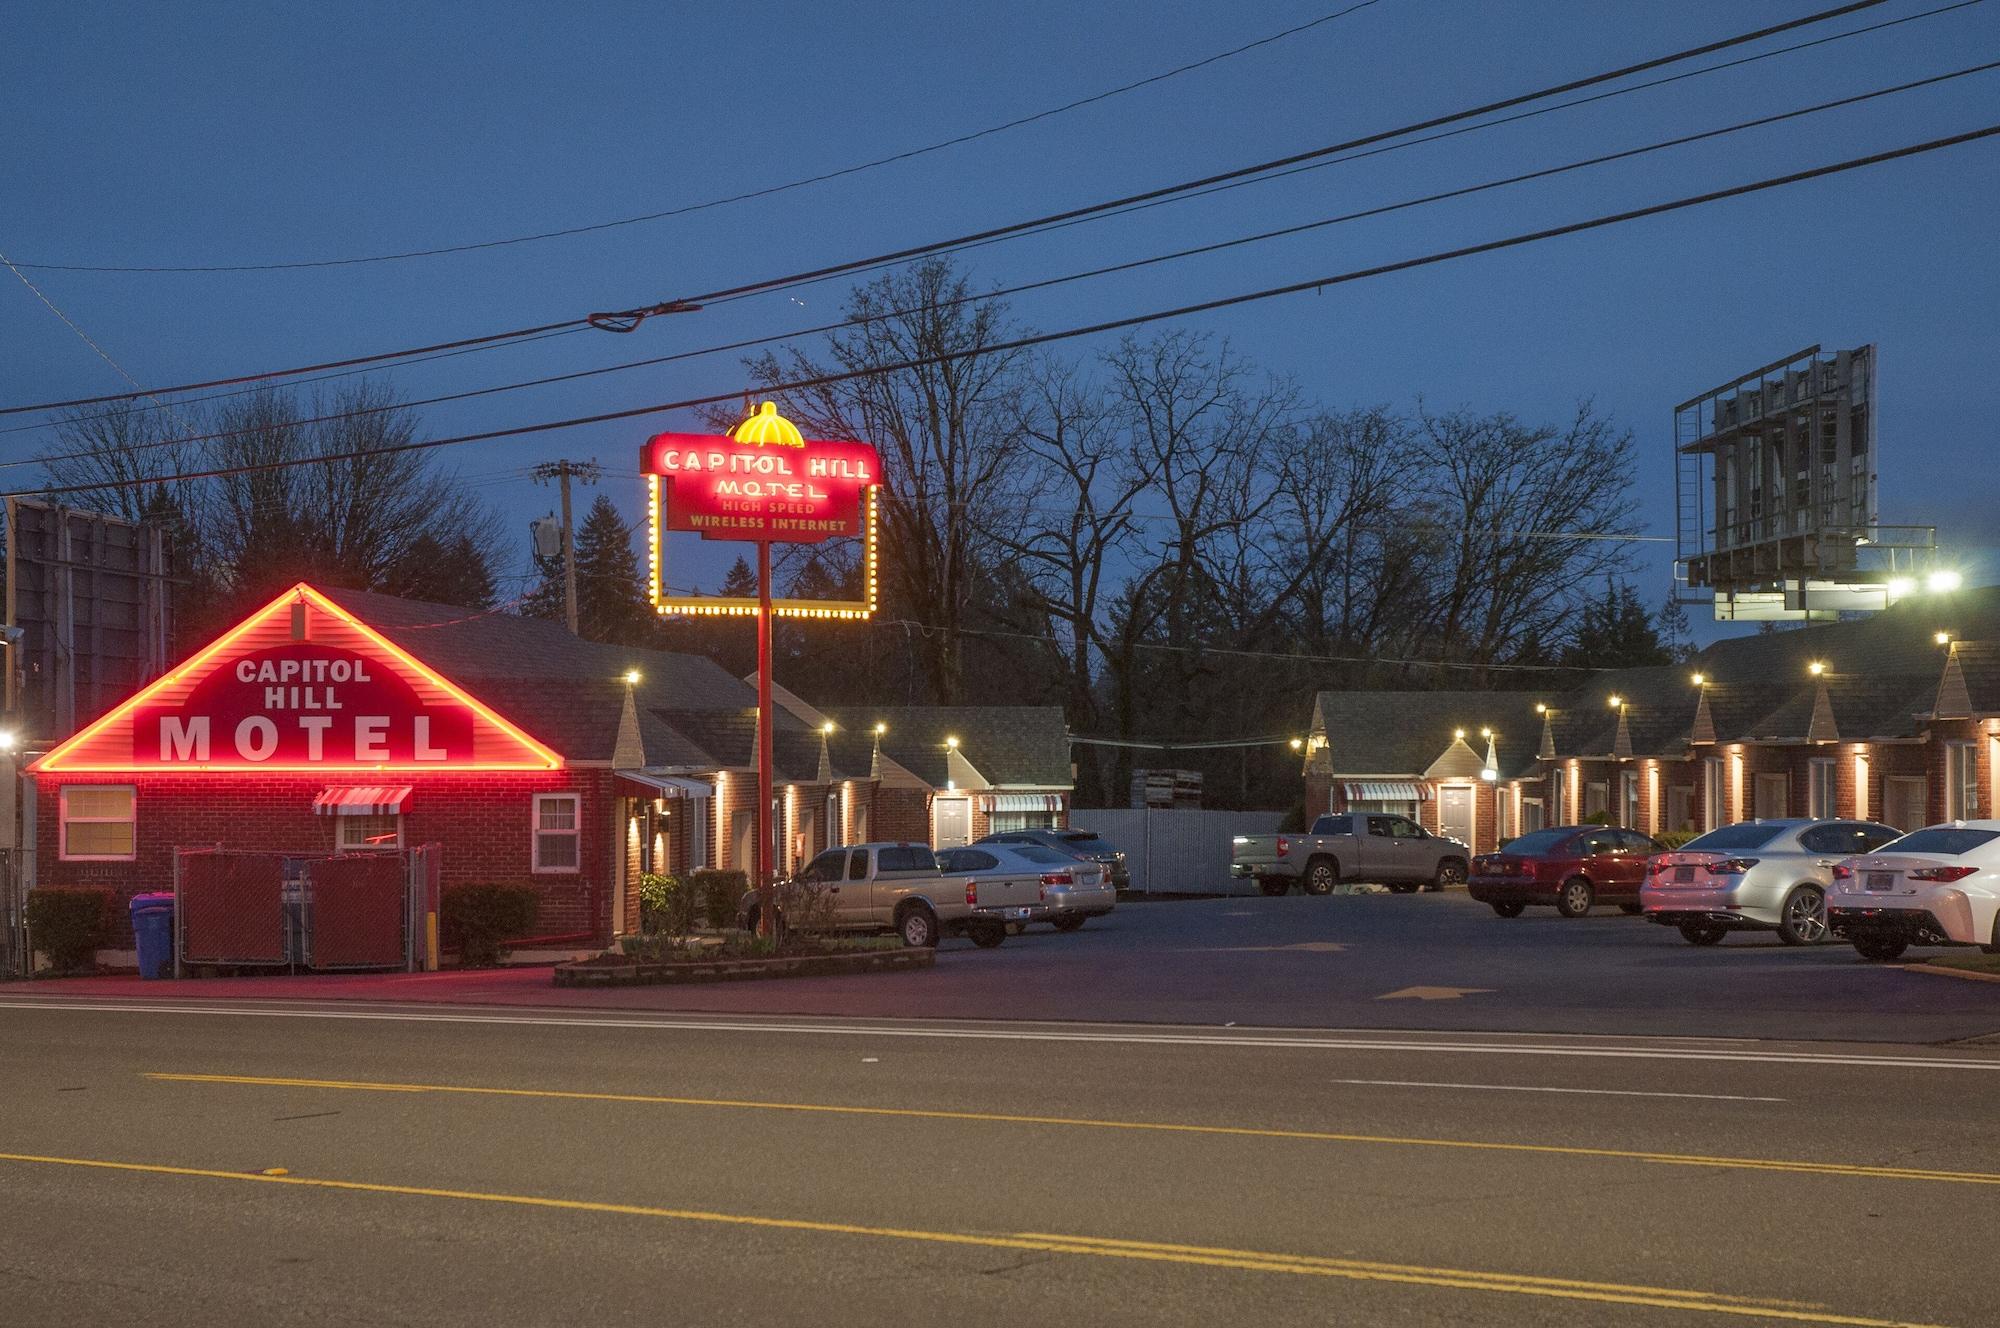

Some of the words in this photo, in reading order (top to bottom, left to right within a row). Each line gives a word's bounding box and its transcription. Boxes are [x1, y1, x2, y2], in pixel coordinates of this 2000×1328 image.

[663, 450, 793, 476] CAPITOL
[810, 458, 871, 479] HILL
[716, 480, 828, 499] MOTEL
[722, 501, 761, 512] HIGH
[769, 502, 815, 514] SPEED
[690, 515, 765, 528] WIRELESS
[772, 518, 847, 531] INTERNET
[236, 659, 371, 683] CAPITOL
[264, 686, 343, 709] HILL
[159, 715, 448, 761] MOTEL
